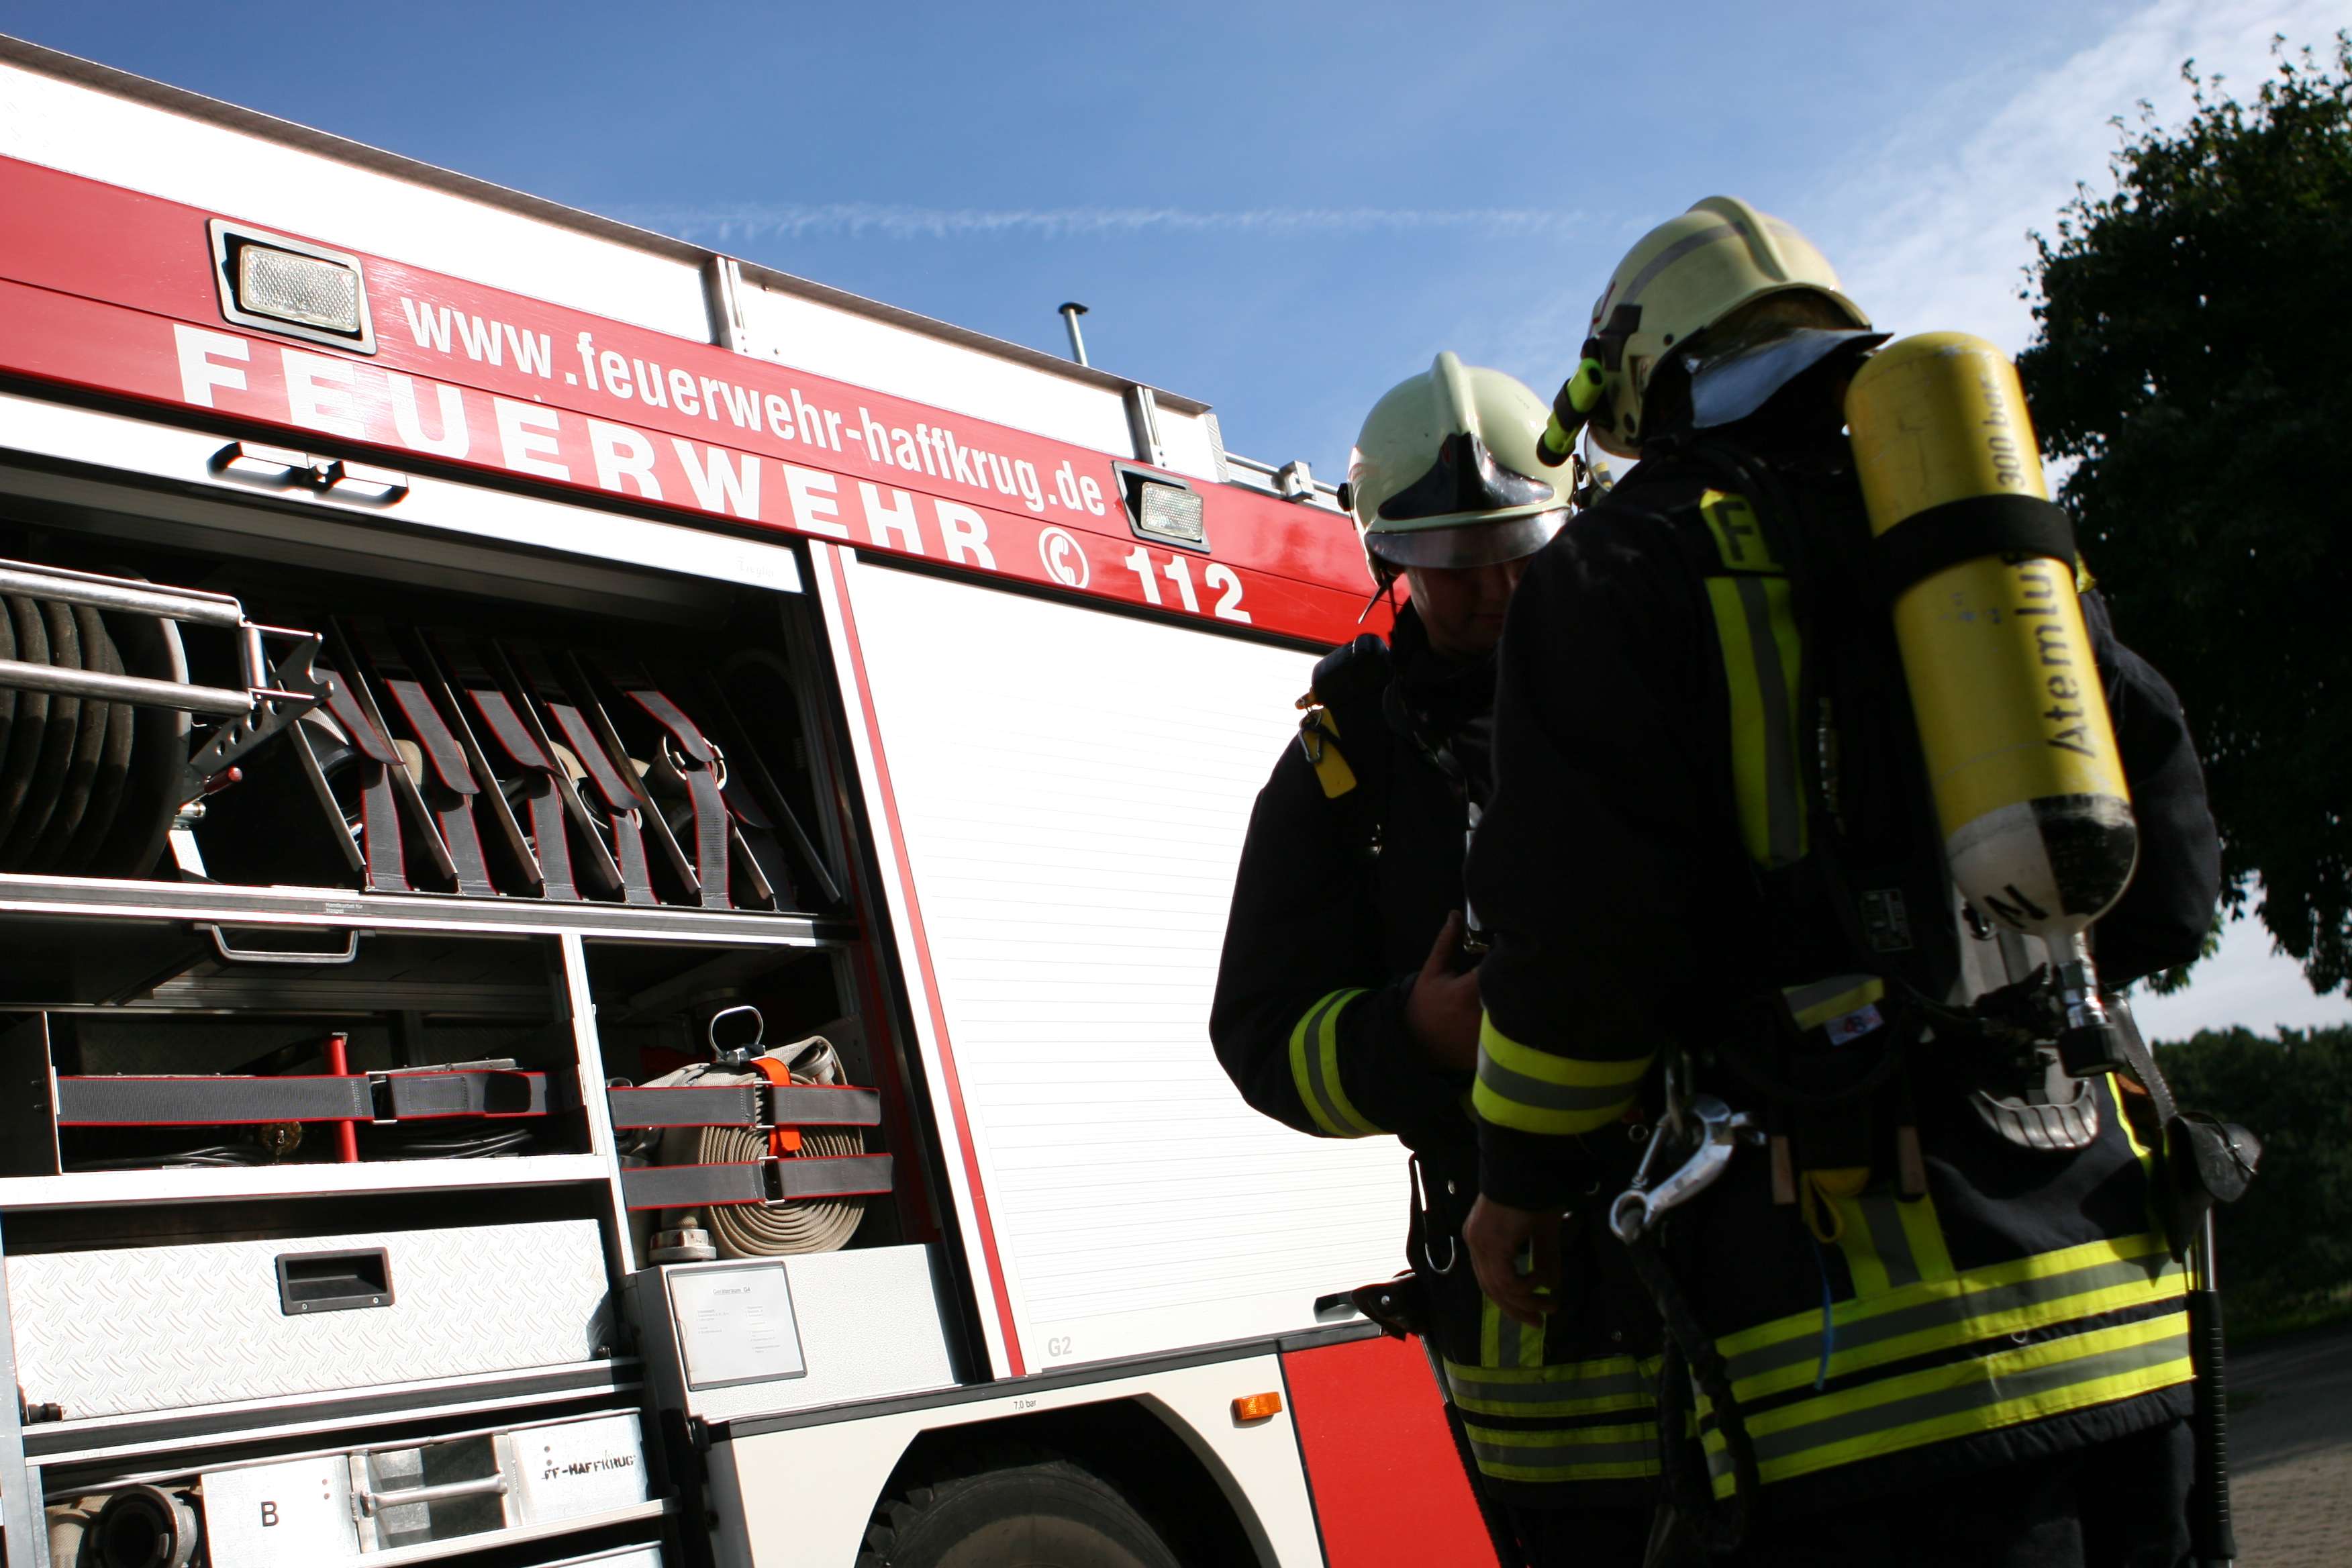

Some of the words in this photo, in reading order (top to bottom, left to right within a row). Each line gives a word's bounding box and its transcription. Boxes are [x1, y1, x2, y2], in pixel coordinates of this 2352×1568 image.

[401, 297, 1106, 516] www.feuerwehr-haffkrug.de
[1981, 375, 2008, 426] bar
[174, 324, 996, 571] FEUERWEHR
[1126, 546, 1251, 623] 112
[1988, 436, 2025, 487] 300
[1716, 501, 1754, 561] F
[2002, 556, 2096, 758] Atemluf
[1048, 1336, 1073, 1357] G2
[1013, 1400, 1024, 1411] 7,0
[1026, 1400, 1036, 1408] bar
[260, 1501, 279, 1527] B
